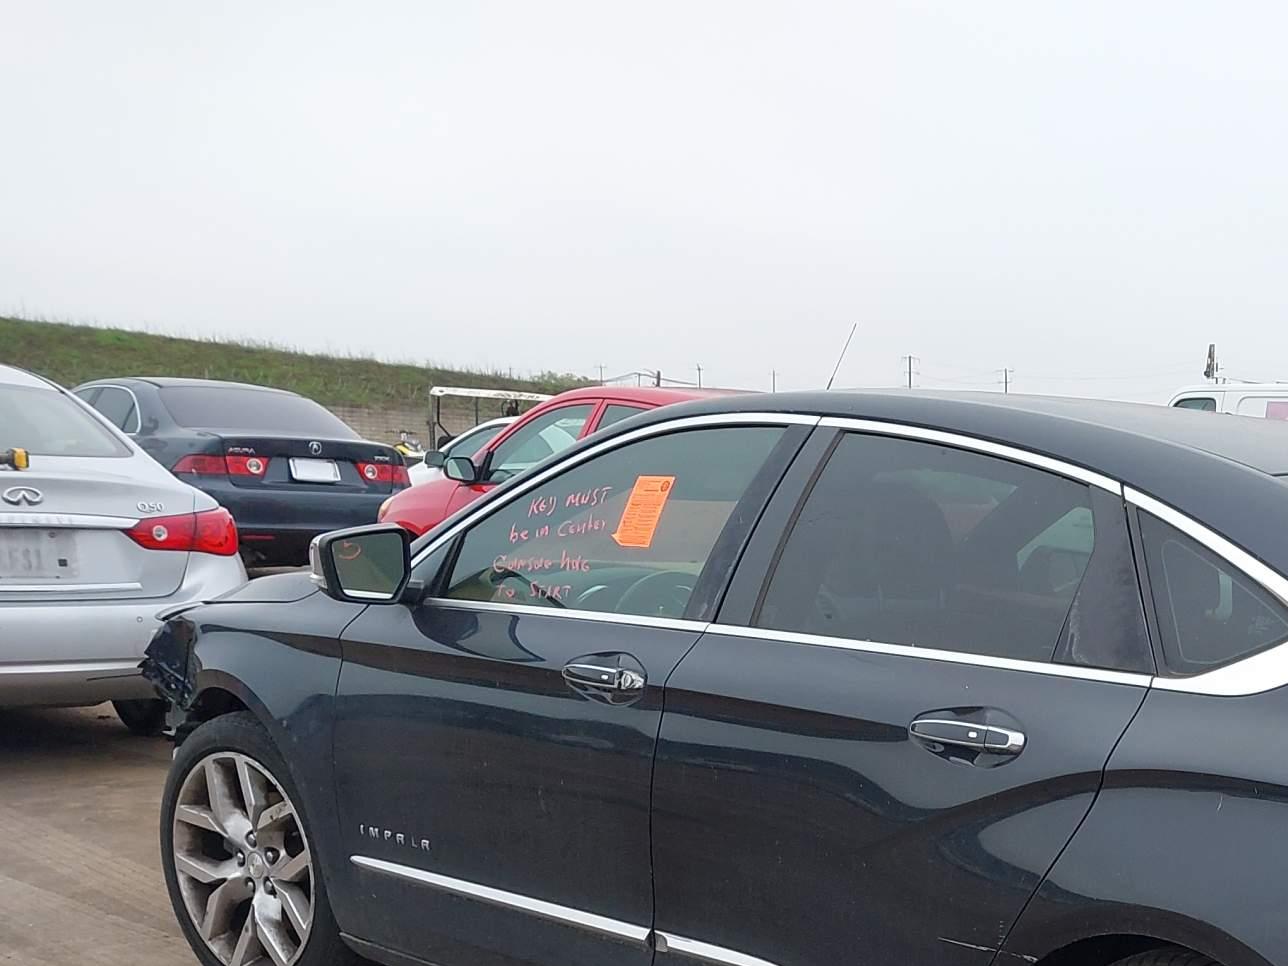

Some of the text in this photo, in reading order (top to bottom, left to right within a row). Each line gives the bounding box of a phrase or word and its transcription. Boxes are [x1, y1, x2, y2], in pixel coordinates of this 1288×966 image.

[137, 501, 165, 512] Q50
[566, 486, 613, 507] MUST
[509, 522, 529, 543] be
[529, 580, 572, 600] START
[360, 824, 430, 851] IMPALA
